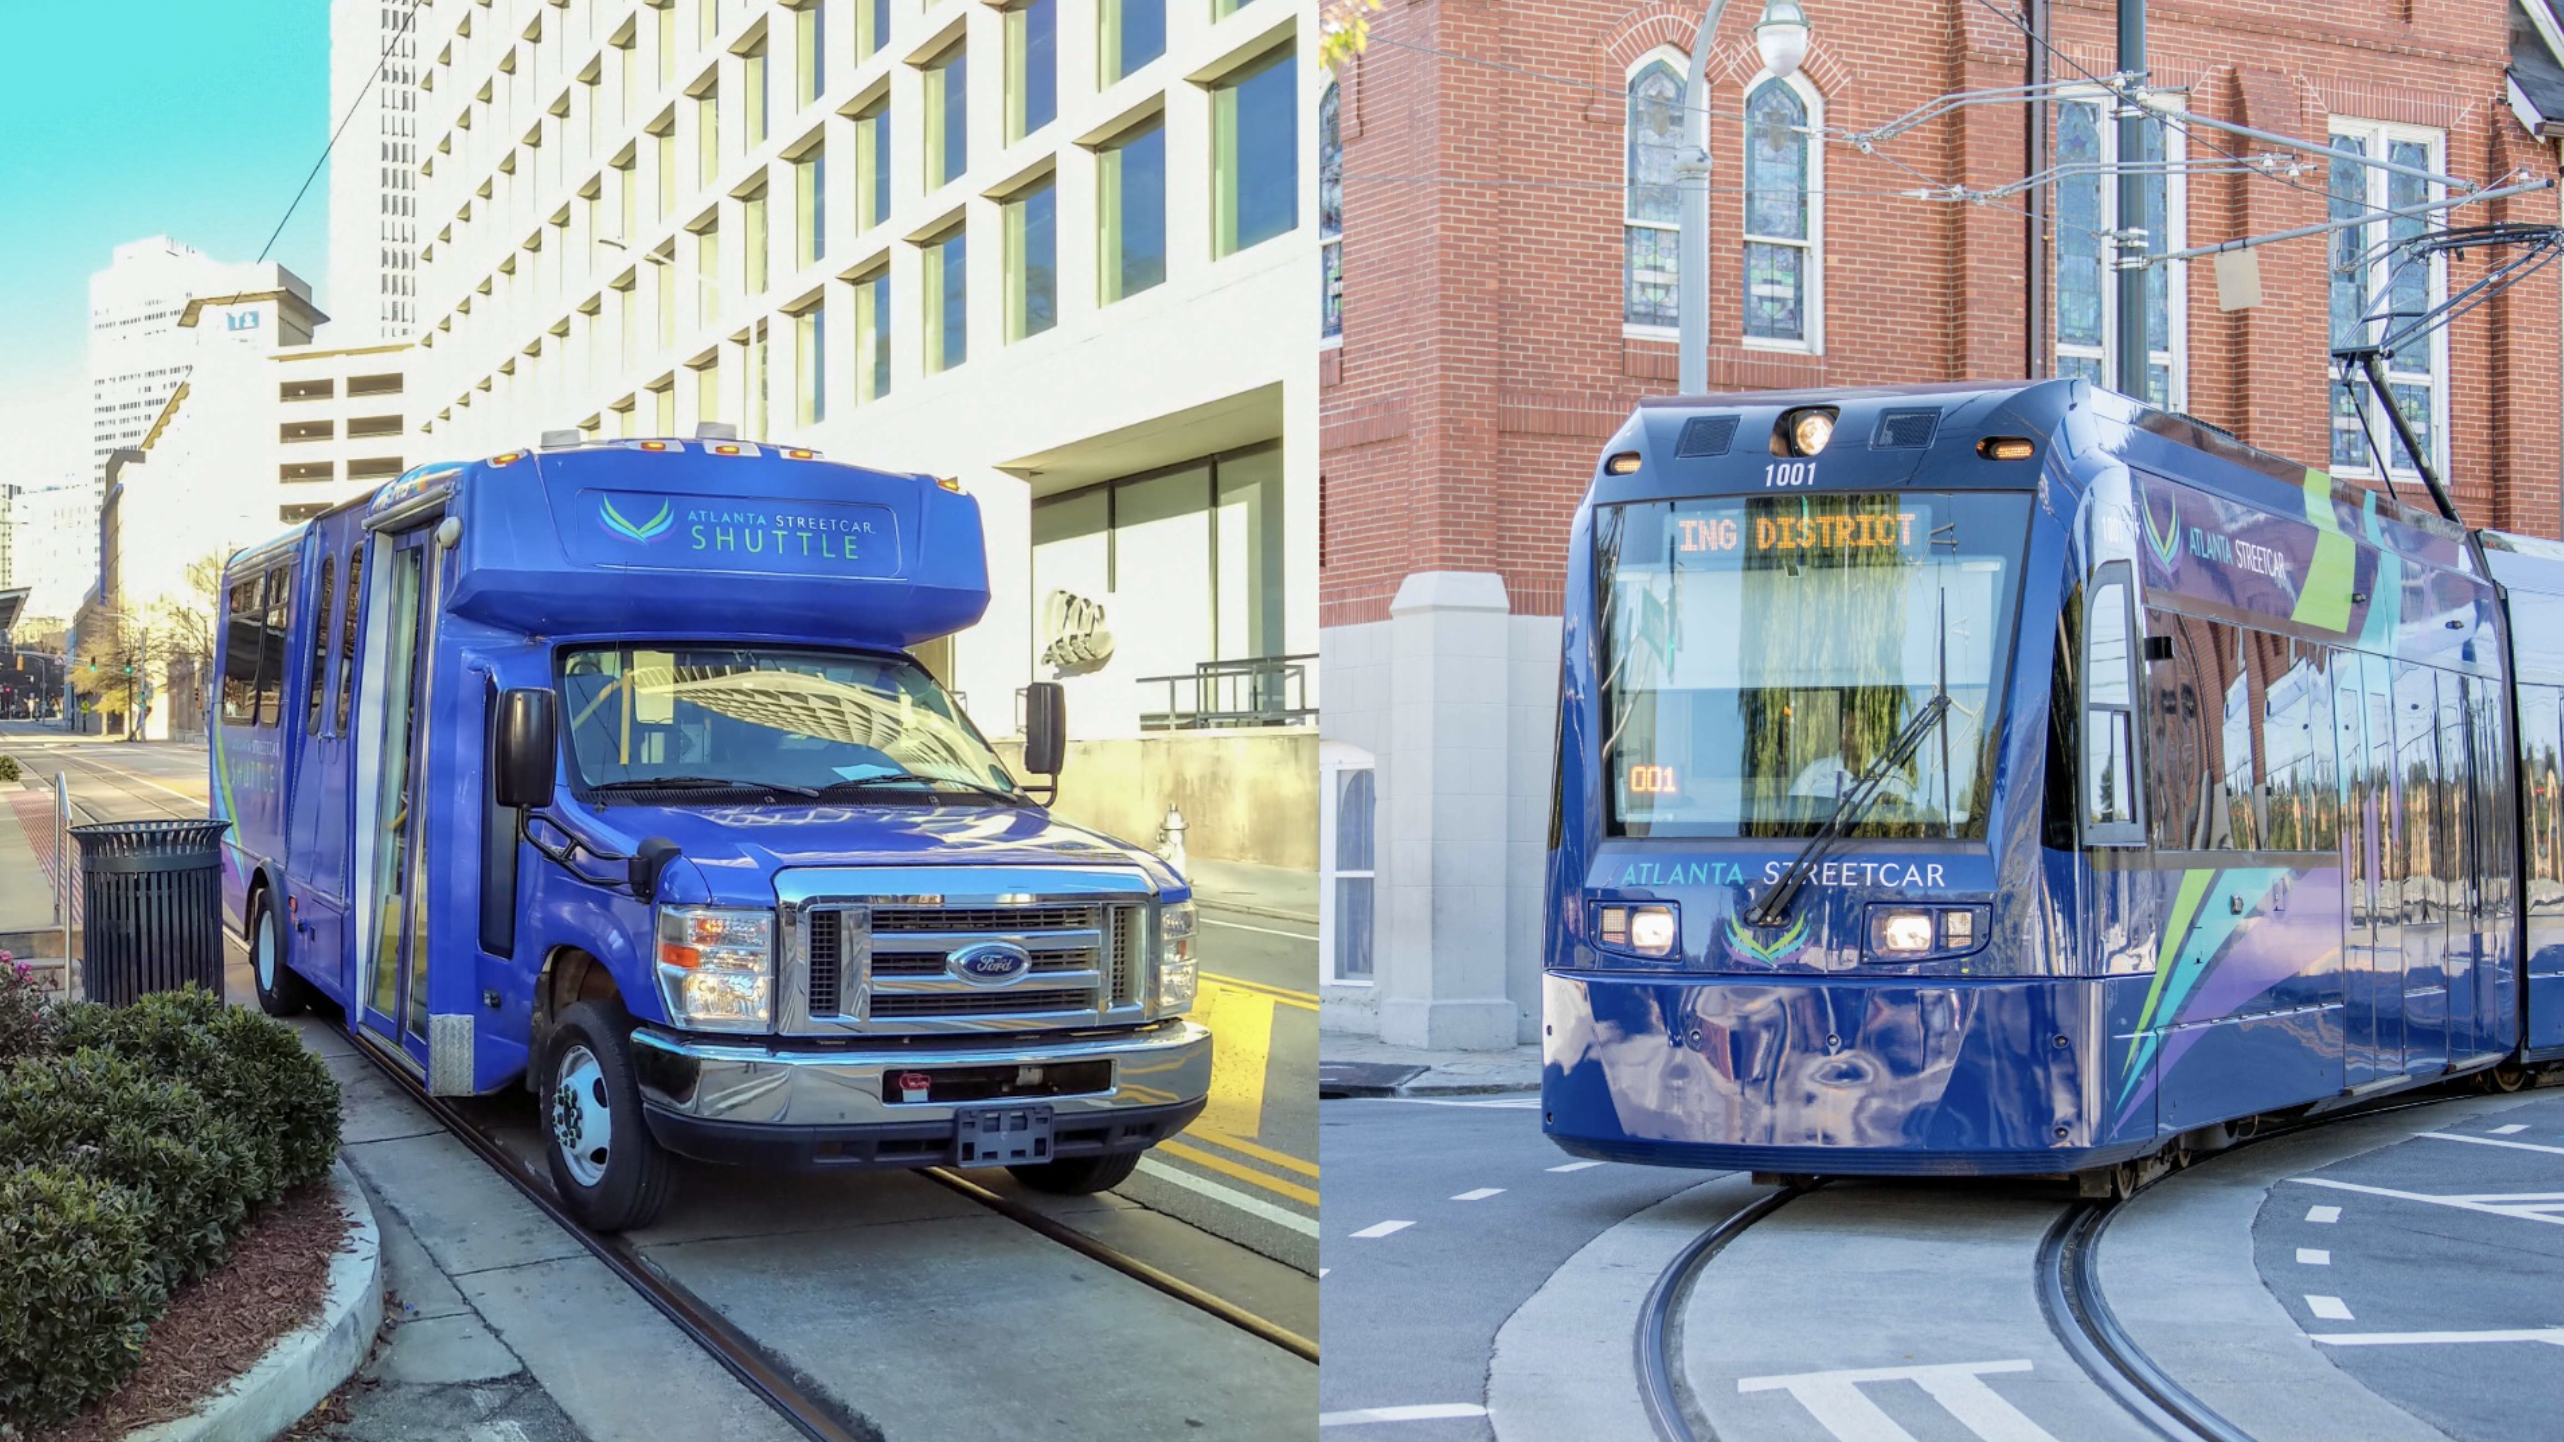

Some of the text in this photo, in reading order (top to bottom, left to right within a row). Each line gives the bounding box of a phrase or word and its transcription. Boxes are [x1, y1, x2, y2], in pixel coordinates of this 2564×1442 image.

[1765, 462, 1816, 487] 1001
[688, 510, 876, 534] ATLANTA STREETCAR
[1679, 513, 1915, 551] ING DISTRICT
[691, 525, 859, 560] SHUTTLE
[2189, 527, 2287, 580] ATLANTA STREETCAR
[1630, 766, 1676, 792] 001
[1620, 861, 1745, 886] ATLANTA
[976, 954, 1013, 972] Ford
